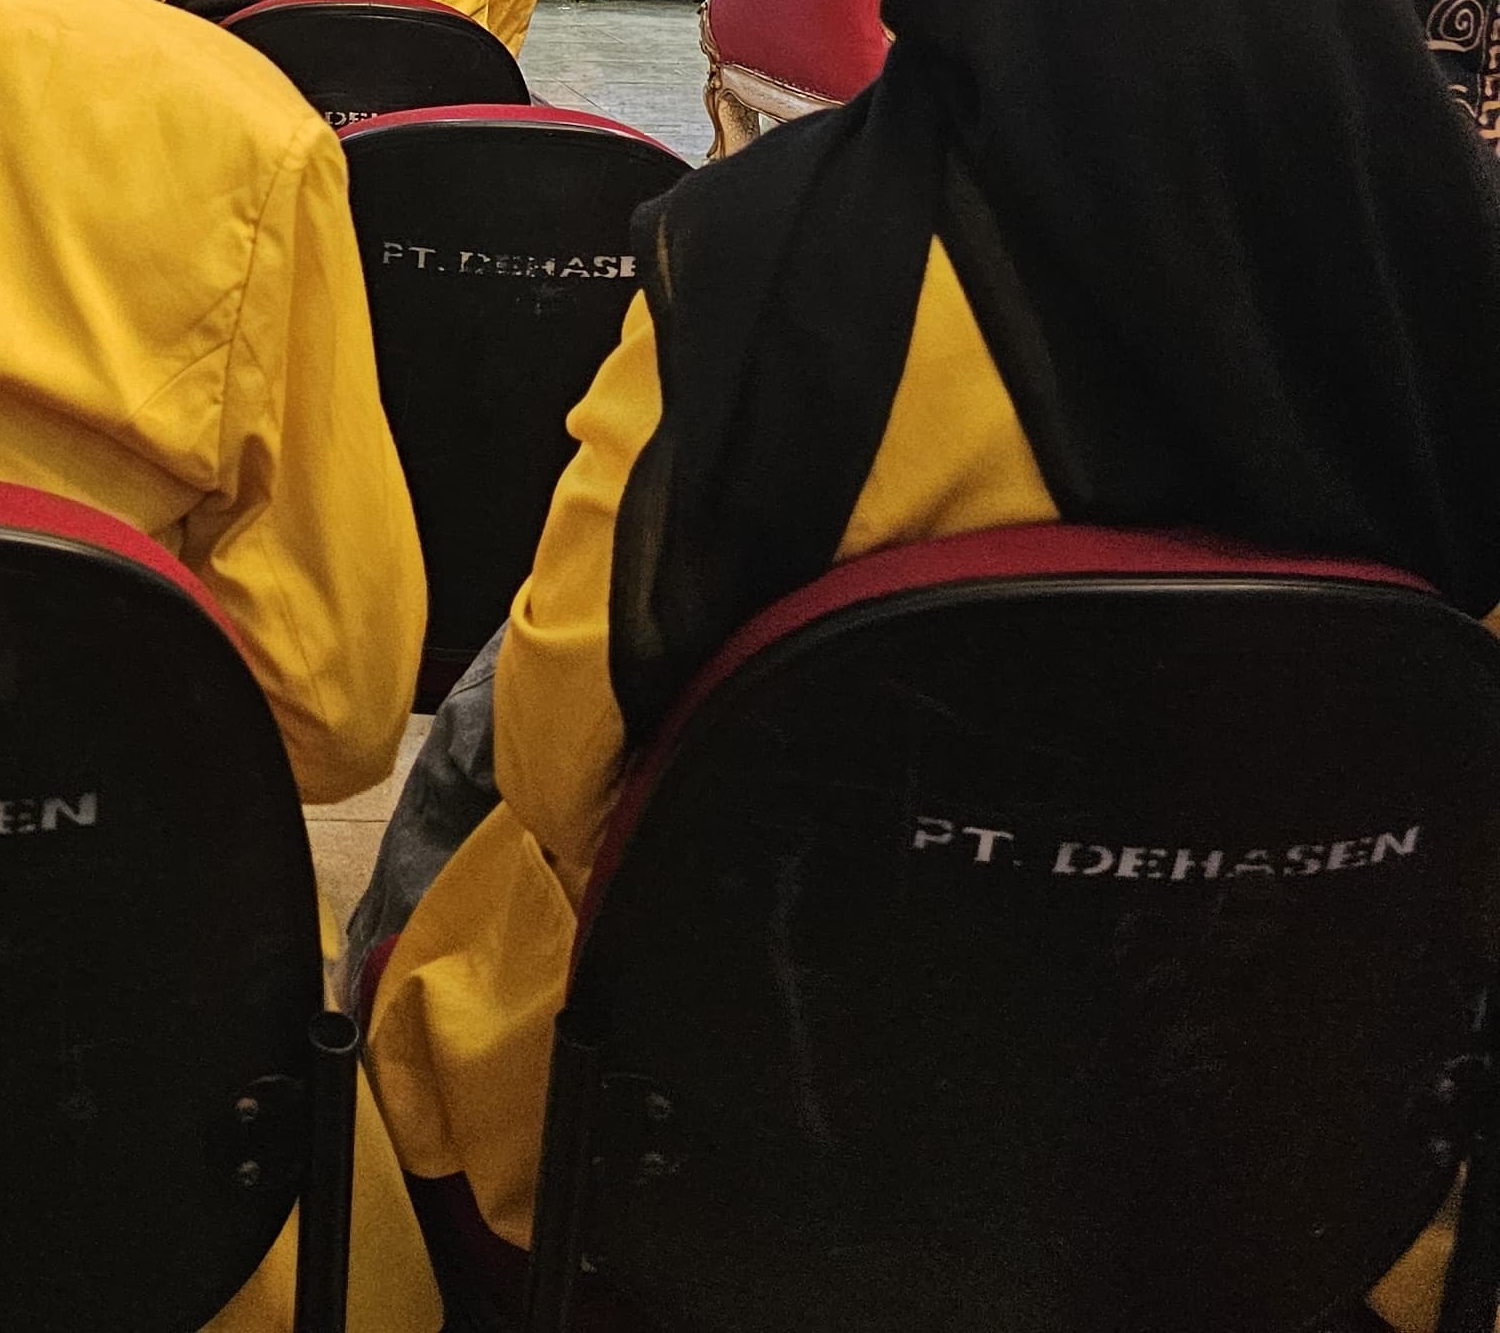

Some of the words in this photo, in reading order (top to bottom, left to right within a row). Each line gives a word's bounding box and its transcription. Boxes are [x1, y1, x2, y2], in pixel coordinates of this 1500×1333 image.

[382, 242, 445, 271] PT.
[460, 251, 636, 279] DEHASE
[912, 816, 1024, 868] PT.
[1052, 826, 1422, 881] DEHASEN
